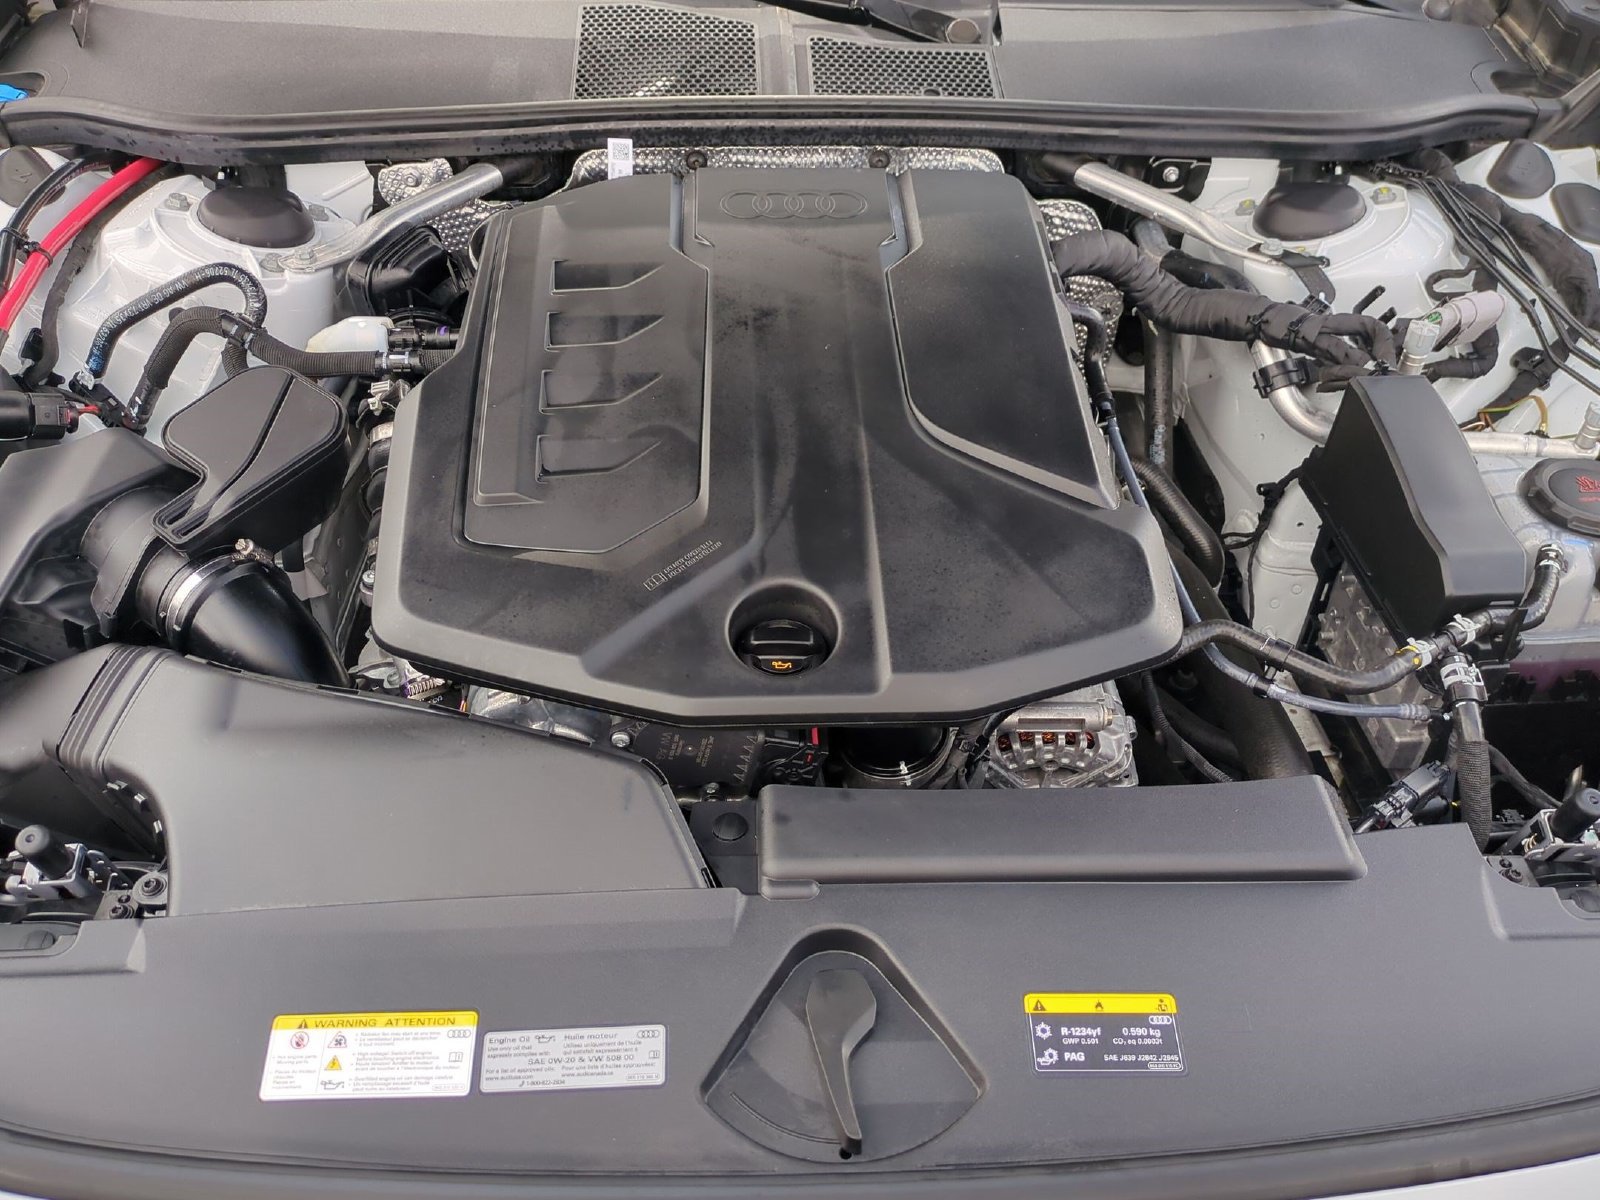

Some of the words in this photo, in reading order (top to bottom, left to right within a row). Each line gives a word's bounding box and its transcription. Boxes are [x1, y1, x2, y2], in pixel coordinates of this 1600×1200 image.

[175, 280, 188, 292] VW
[315, 1018, 376, 1028] WARNING
[385, 1016, 456, 1026] ATTENTION
[1060, 1027, 1102, 1037] R-1234yf
[1122, 1028, 1148, 1036] 0.590
[1150, 1028, 1162, 1038] kg
[489, 1036, 516, 1044] Engine
[548, 1056, 576, 1064] 0W-20
[1064, 1052, 1086, 1061] PAG
